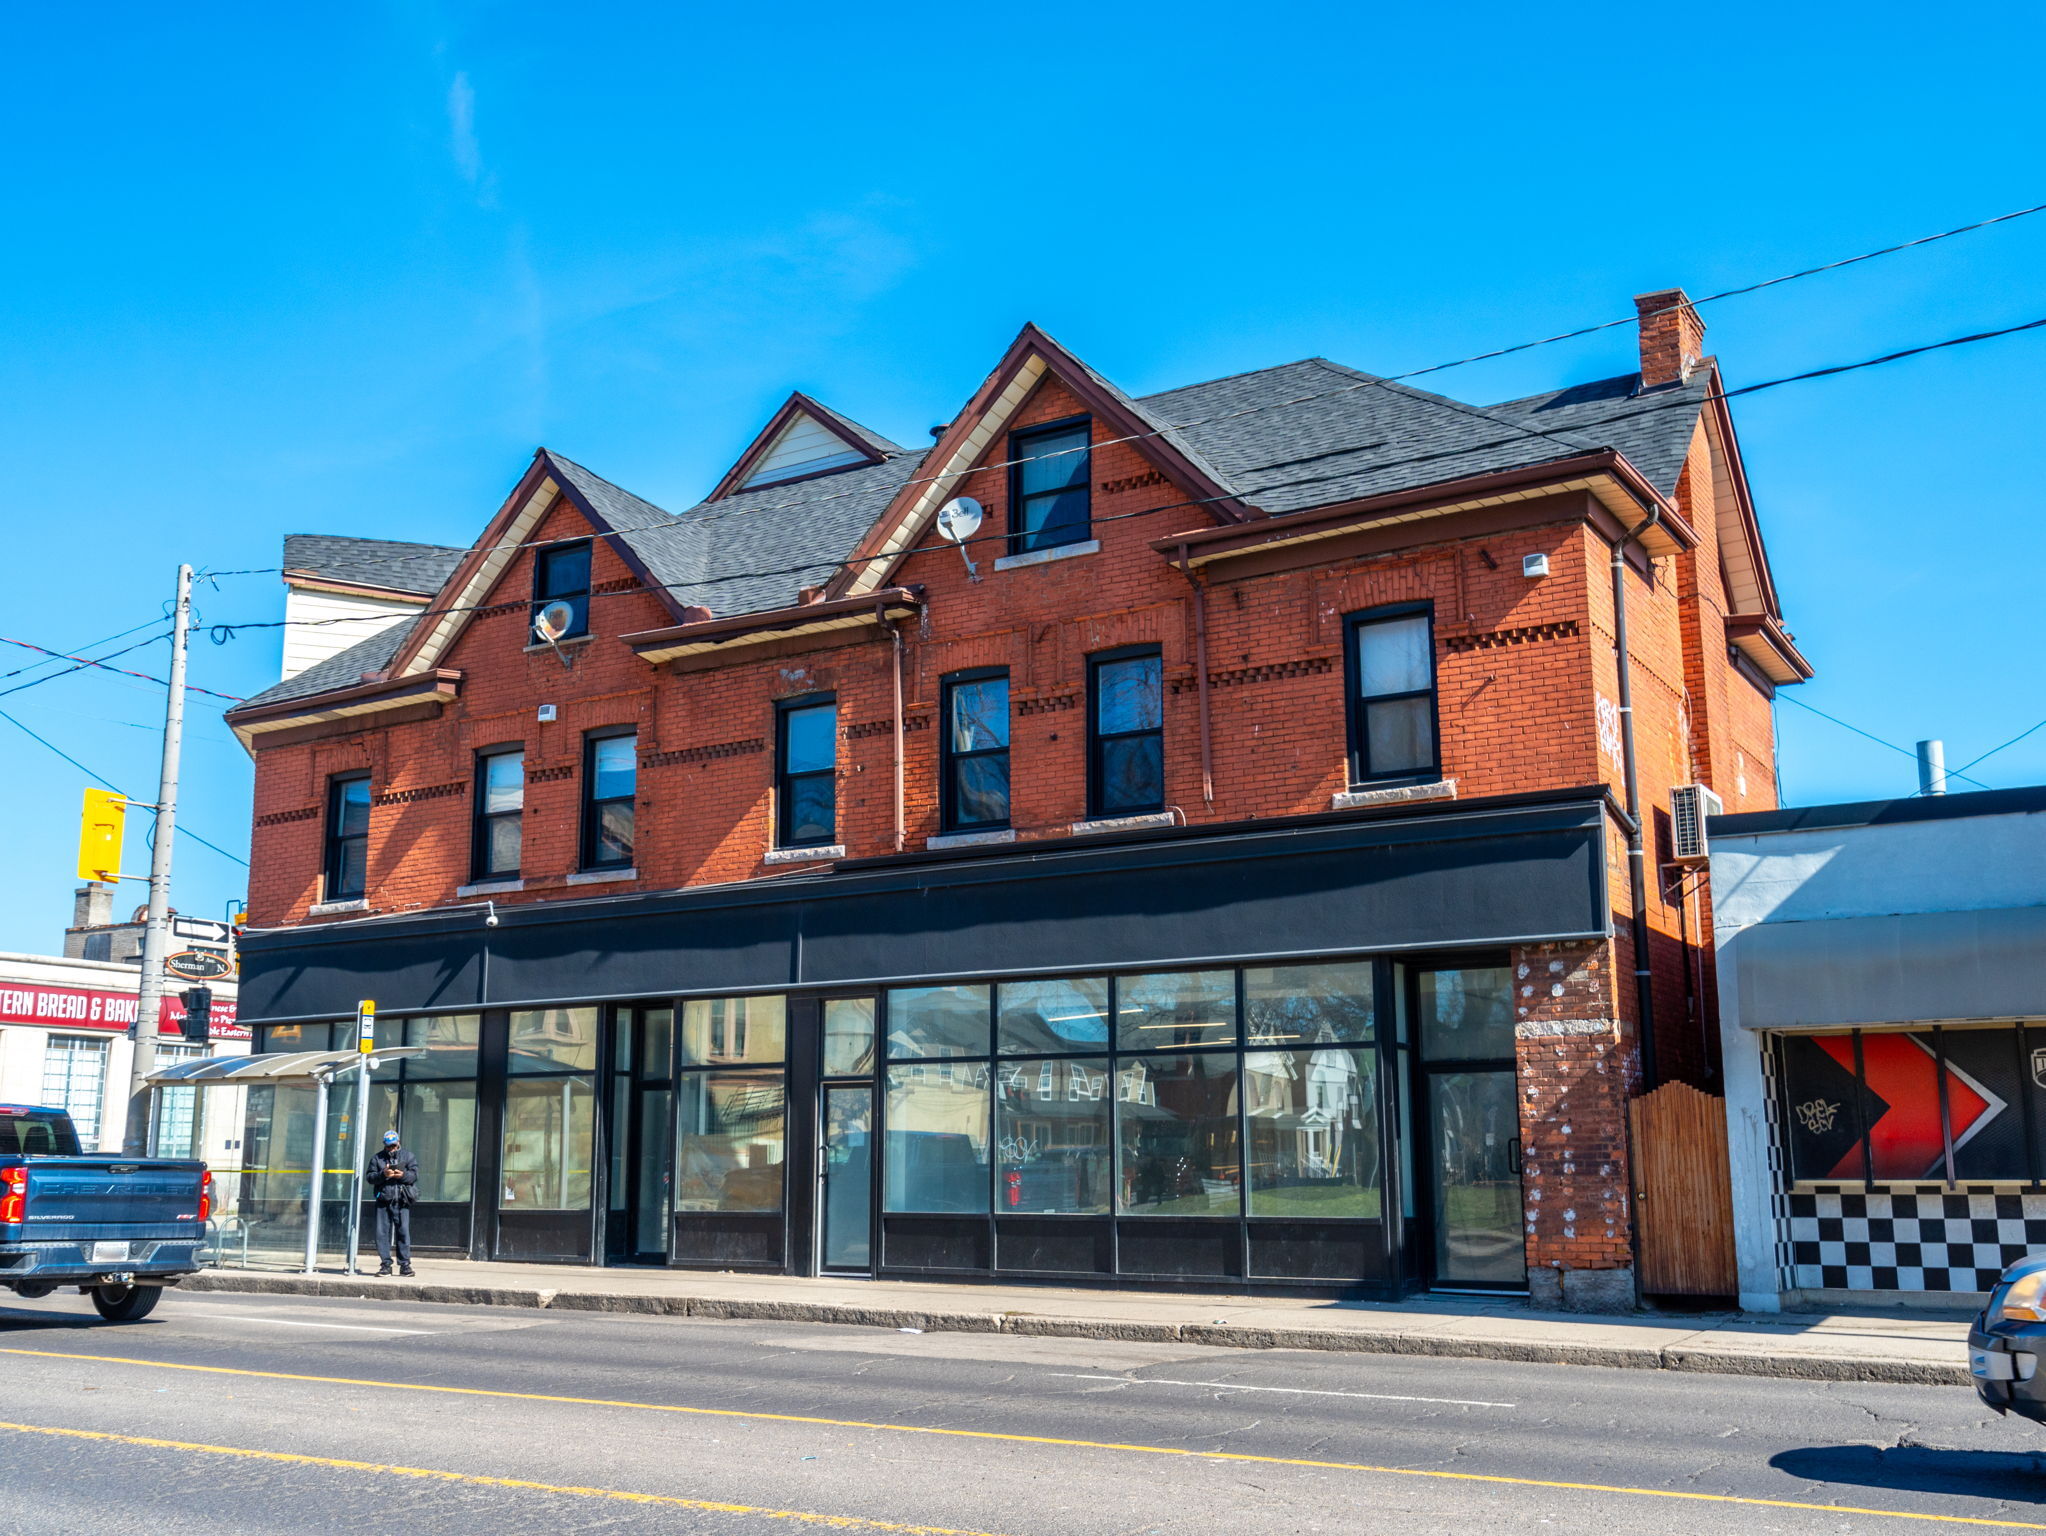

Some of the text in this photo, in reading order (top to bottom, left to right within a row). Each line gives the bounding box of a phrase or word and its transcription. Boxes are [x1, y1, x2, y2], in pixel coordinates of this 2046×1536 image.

[170, 959, 225, 973] Sherman N
[36, 992, 88, 1020] BREAD
[90, 997, 102, 1021] &
[220, 1027, 249, 1037] Eastern
